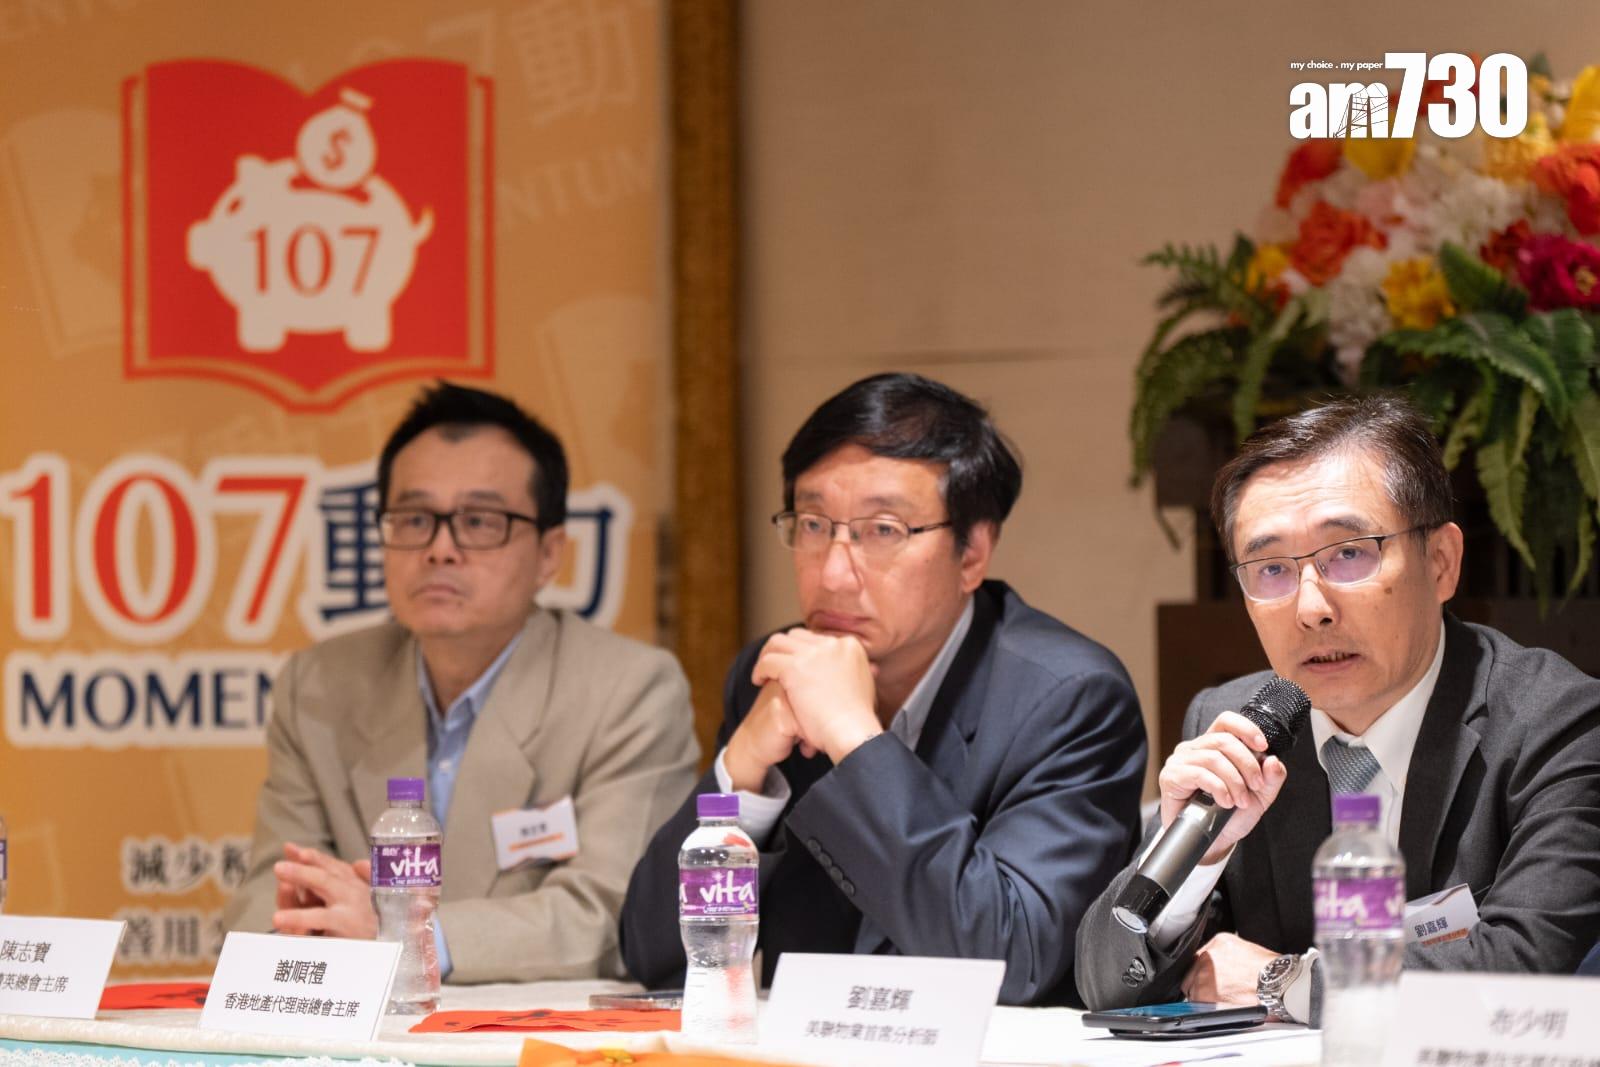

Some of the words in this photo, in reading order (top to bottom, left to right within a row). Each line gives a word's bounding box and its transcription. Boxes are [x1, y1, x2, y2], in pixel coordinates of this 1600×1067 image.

[243, 224, 381, 297] 107
[390, 847, 439, 877] vita
[699, 870, 755, 903] vita
[0, 972, 69, 993] 英總會主席
[273, 959, 328, 985] 謝順禮
[224, 992, 360, 1018] 香港地產代理商總會主席
